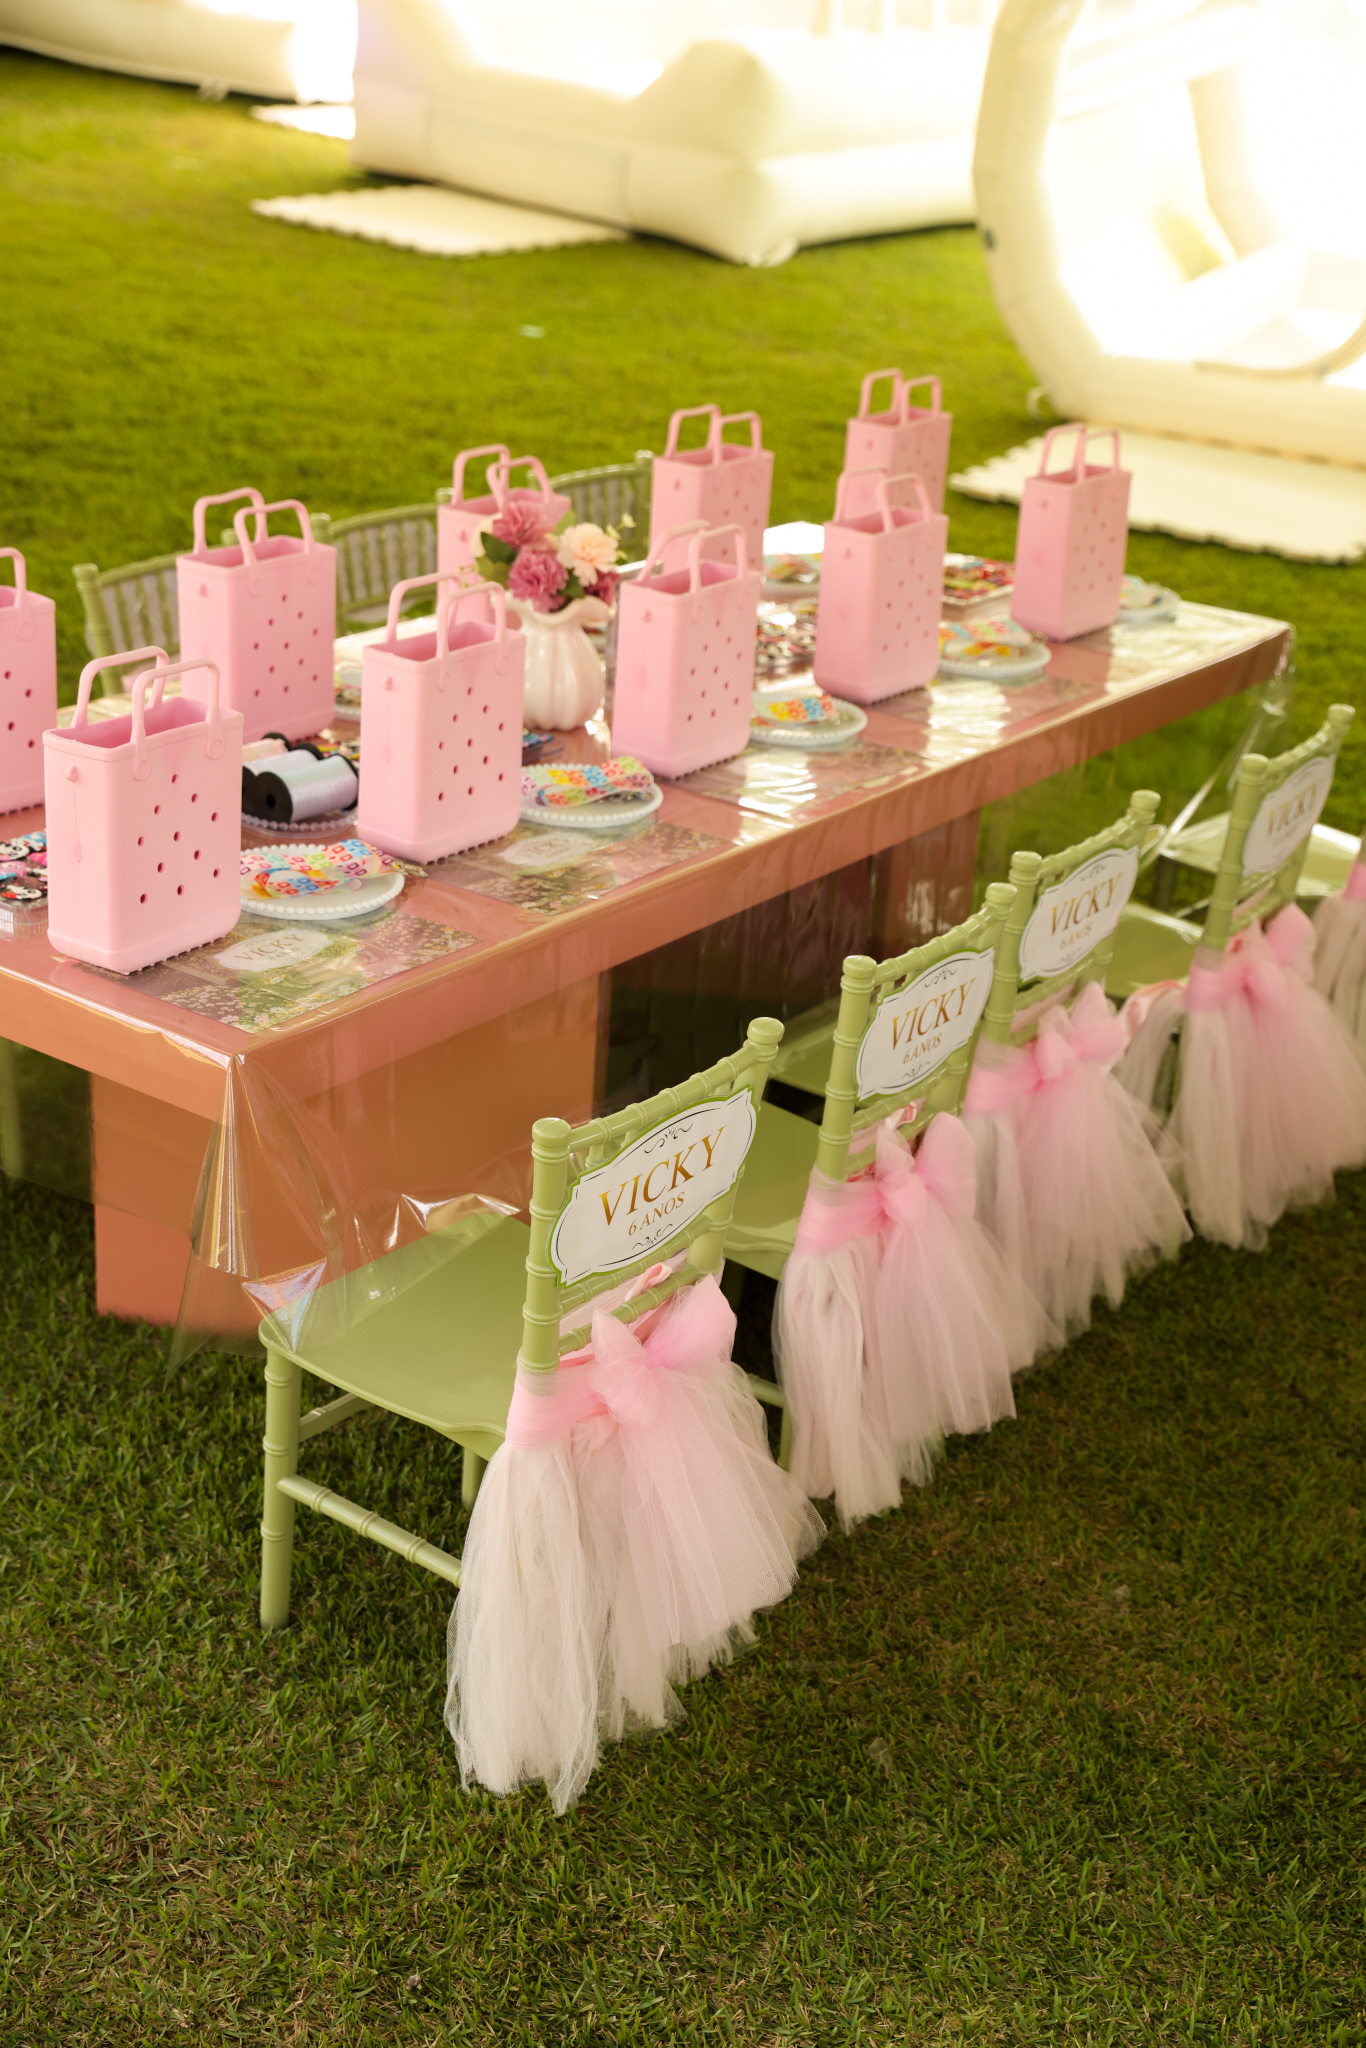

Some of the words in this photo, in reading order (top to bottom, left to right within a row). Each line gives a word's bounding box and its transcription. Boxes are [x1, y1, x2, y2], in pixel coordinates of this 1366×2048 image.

[1051, 872, 1123, 936] VICKY
[233, 934, 304, 960] VICKY
[891, 977, 976, 1050] VICKY
[910, 1032, 943, 1061] ANOS
[598, 1125, 726, 1226] VICKY
[628, 1218, 638, 1236] 6
[639, 1191, 685, 1230] ANOS
